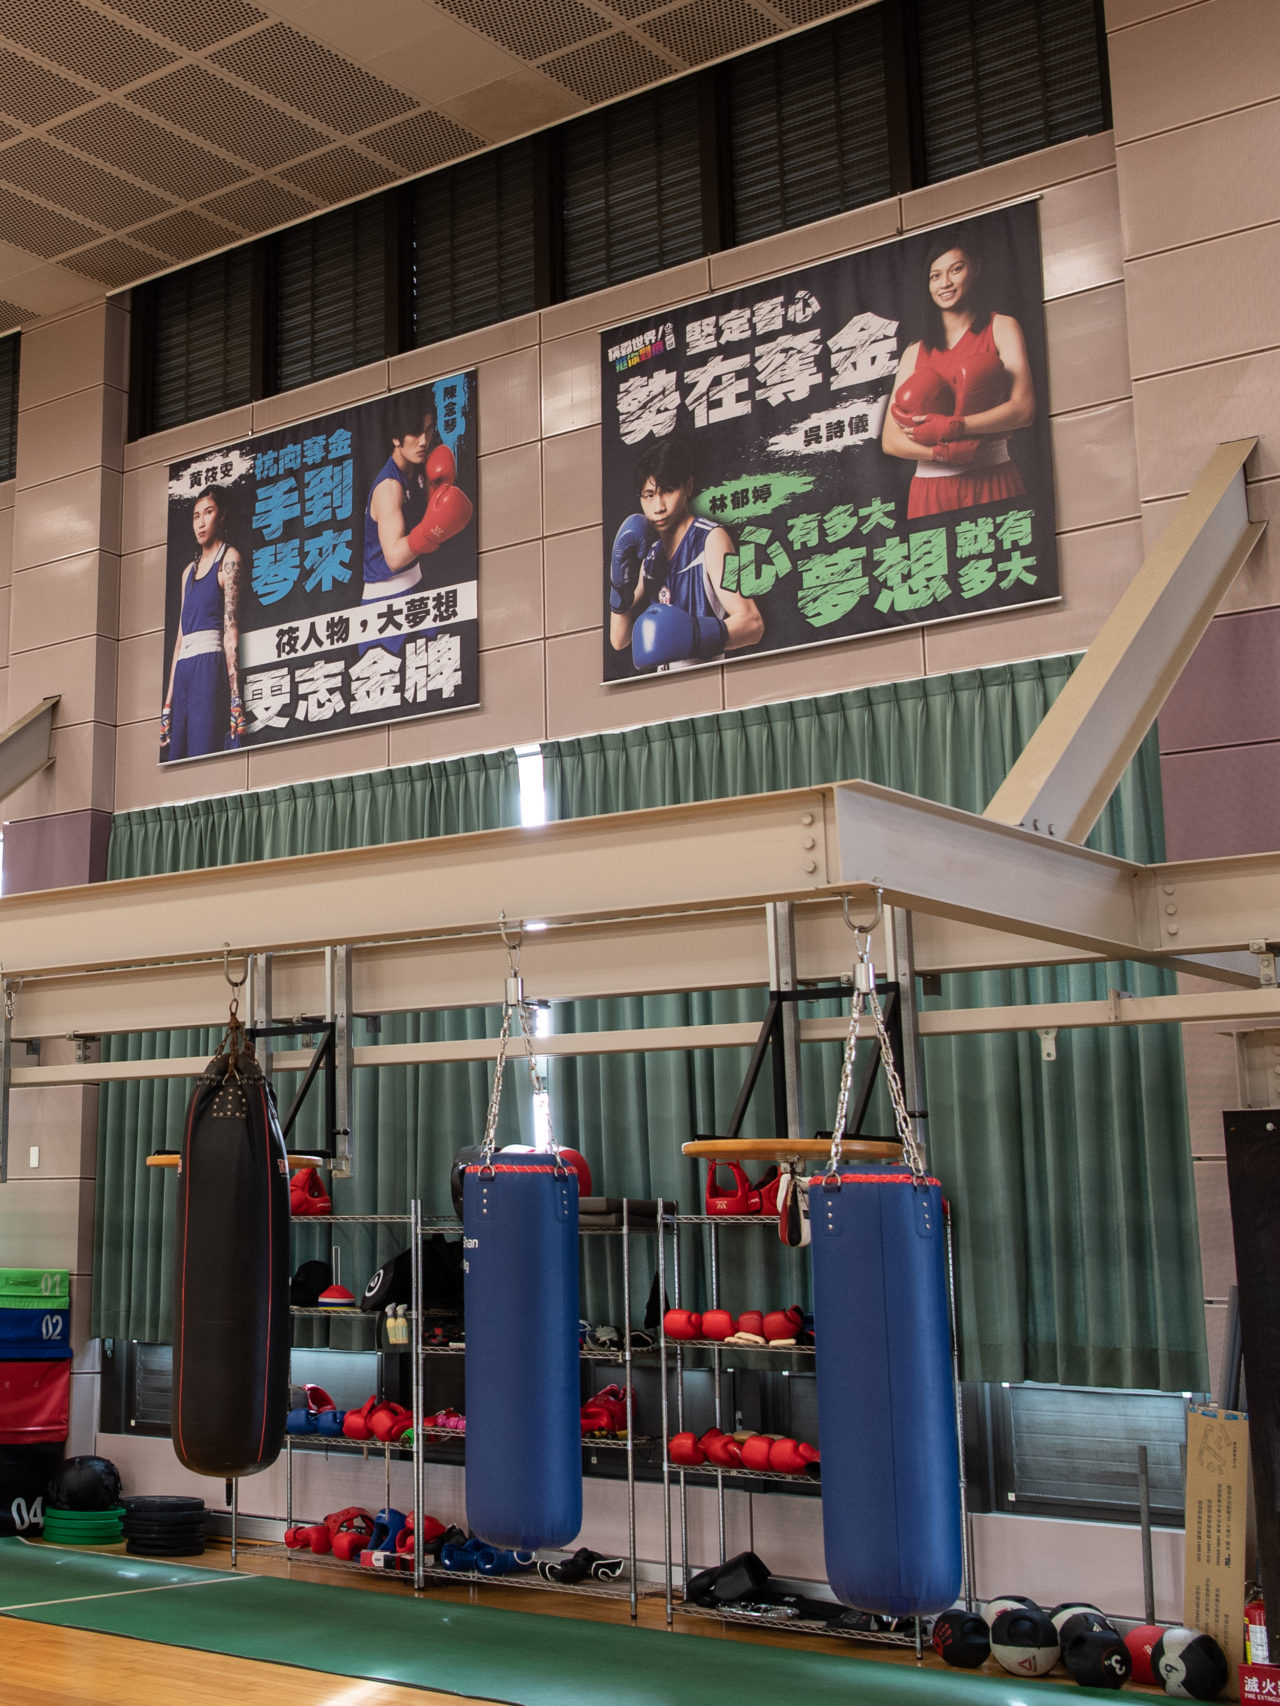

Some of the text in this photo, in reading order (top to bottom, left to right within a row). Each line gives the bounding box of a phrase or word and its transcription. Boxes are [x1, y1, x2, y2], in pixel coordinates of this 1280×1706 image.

[685, 290, 821, 355] 堅定吾心
[616, 311, 900, 445] 勢在奪金
[443, 384, 458, 434] 陳念琴
[803, 413, 869, 447] 吳詩儀
[252, 457, 353, 542] 手到
[708, 484, 773, 515] 林郁婷
[787, 497, 896, 548] 有多大
[954, 509, 1035, 558] 就有
[250, 528, 353, 607] 琴來
[797, 526, 953, 628] 夢想
[958, 554, 1038, 600] 多大
[242, 633, 463, 729] 雯志金牌
[40, 1273, 61, 1296] 01
[41, 1314, 63, 1341] 02
[11, 1495, 45, 1531] 04
